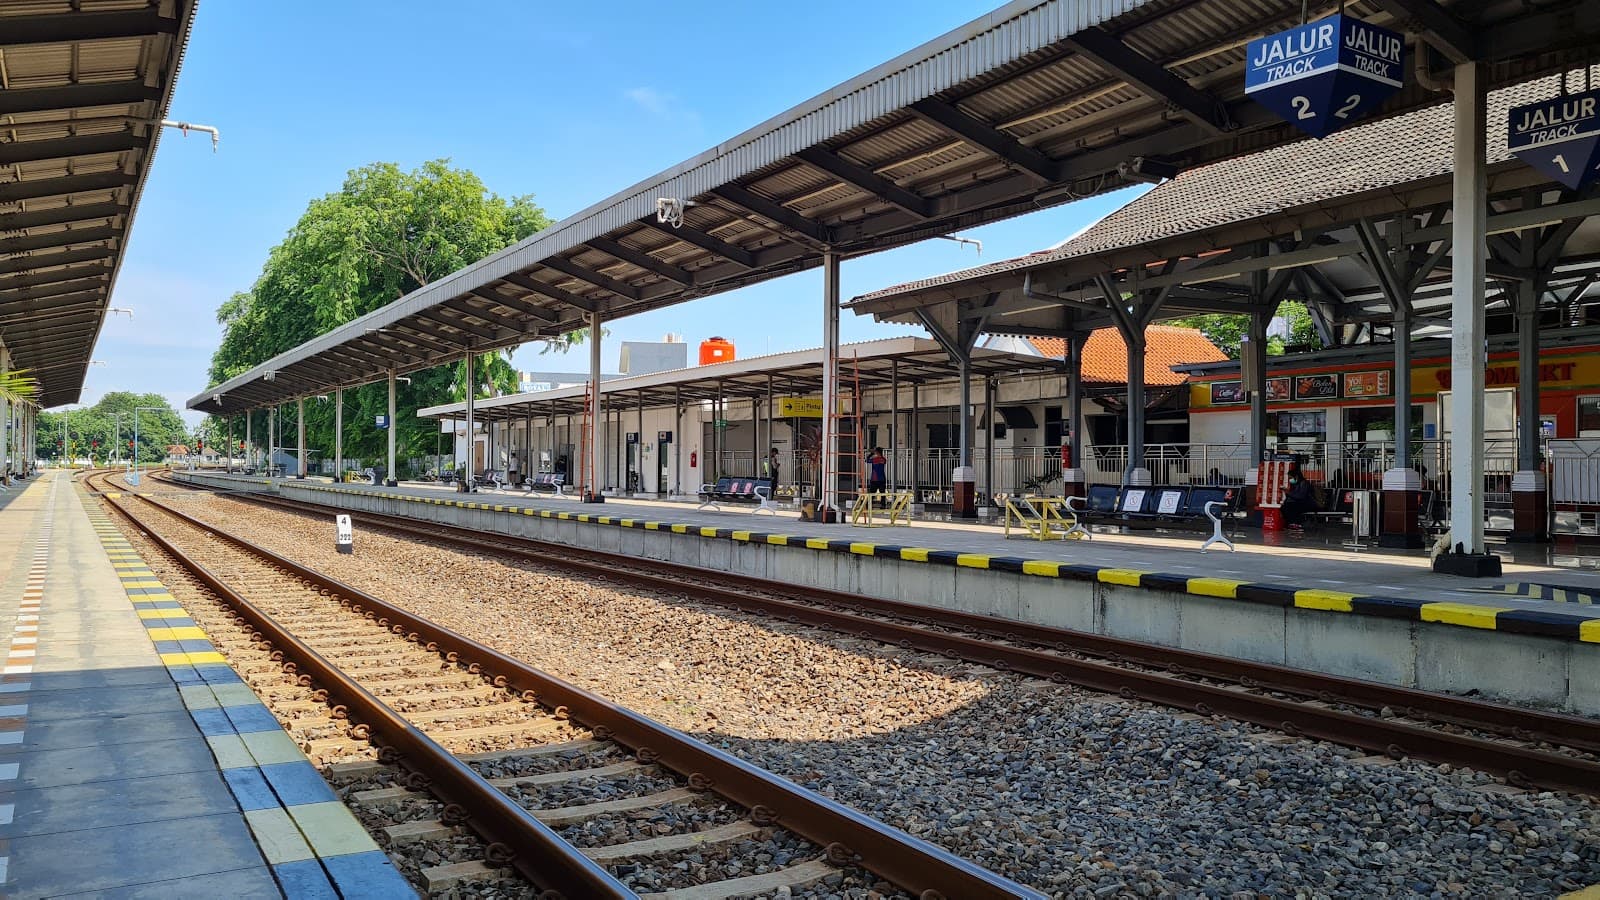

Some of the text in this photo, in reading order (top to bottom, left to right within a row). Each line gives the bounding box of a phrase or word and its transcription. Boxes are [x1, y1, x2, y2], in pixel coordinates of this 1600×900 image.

[1254, 24, 1333, 67] JALUR
[1345, 25, 1401, 62] JALUR
[1267, 56, 1316, 81] TRACK
[1355, 55, 1389, 78] TRACK
[1291, 96, 1316, 120] 2
[1334, 94, 1361, 119] 2
[1517, 97, 1596, 131] JALUR
[1530, 123, 1580, 144] TRACK
[1552, 154, 1569, 173] 1
[342, 517, 347, 525] 4
